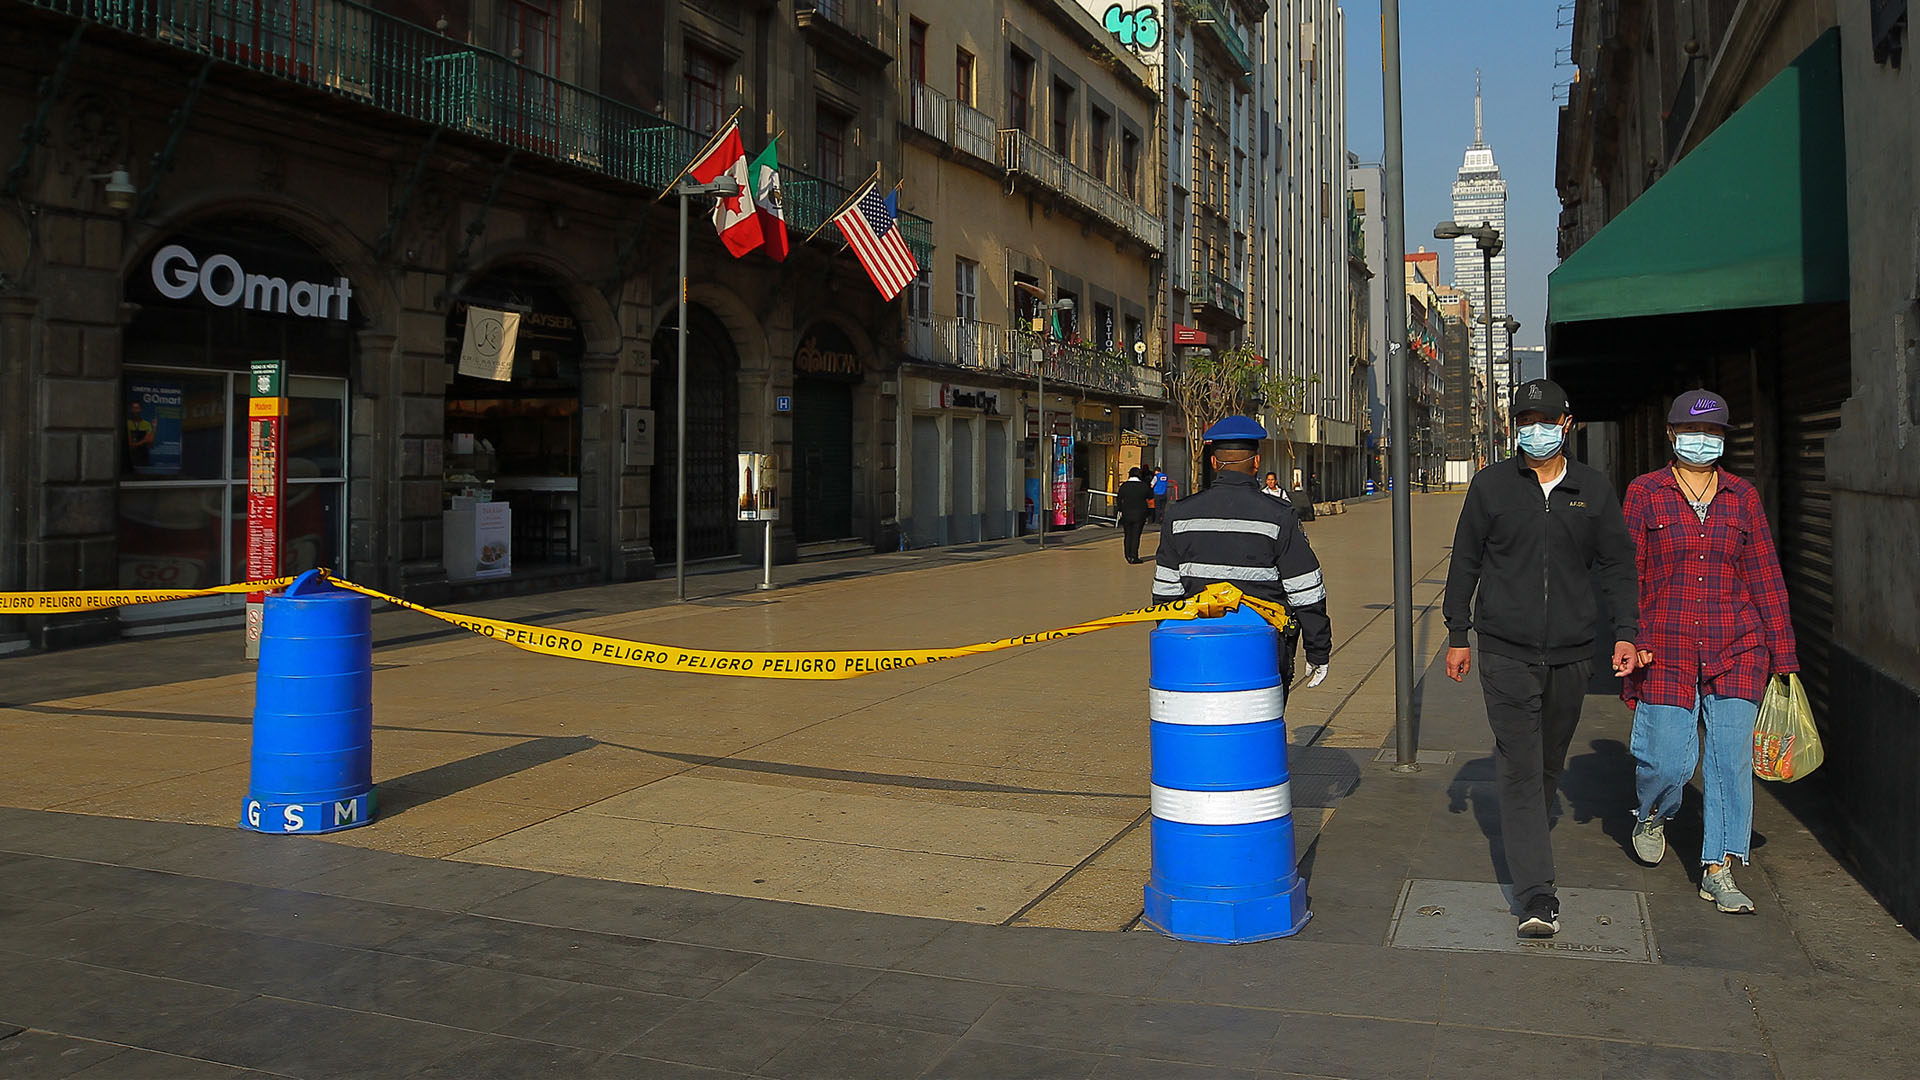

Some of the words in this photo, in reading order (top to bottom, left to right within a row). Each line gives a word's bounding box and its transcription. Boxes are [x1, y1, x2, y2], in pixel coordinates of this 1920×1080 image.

[151, 244, 352, 321] GOmart
[0, 597, 34, 608] LIGRO
[39, 597, 82, 608] PELIGRO
[87, 596, 130, 607] PELIGRO
[505, 628, 583, 652] PELIGRO
[592, 642, 668, 664] PELIGRO
[676, 654, 753, 671] PELIGRO
[762, 658, 836, 673] PELIGRO
[845, 657, 917, 672] PELIGRO
[247, 800, 261, 828] G
[283, 804, 304, 832] S
[334, 799, 358, 826] M
